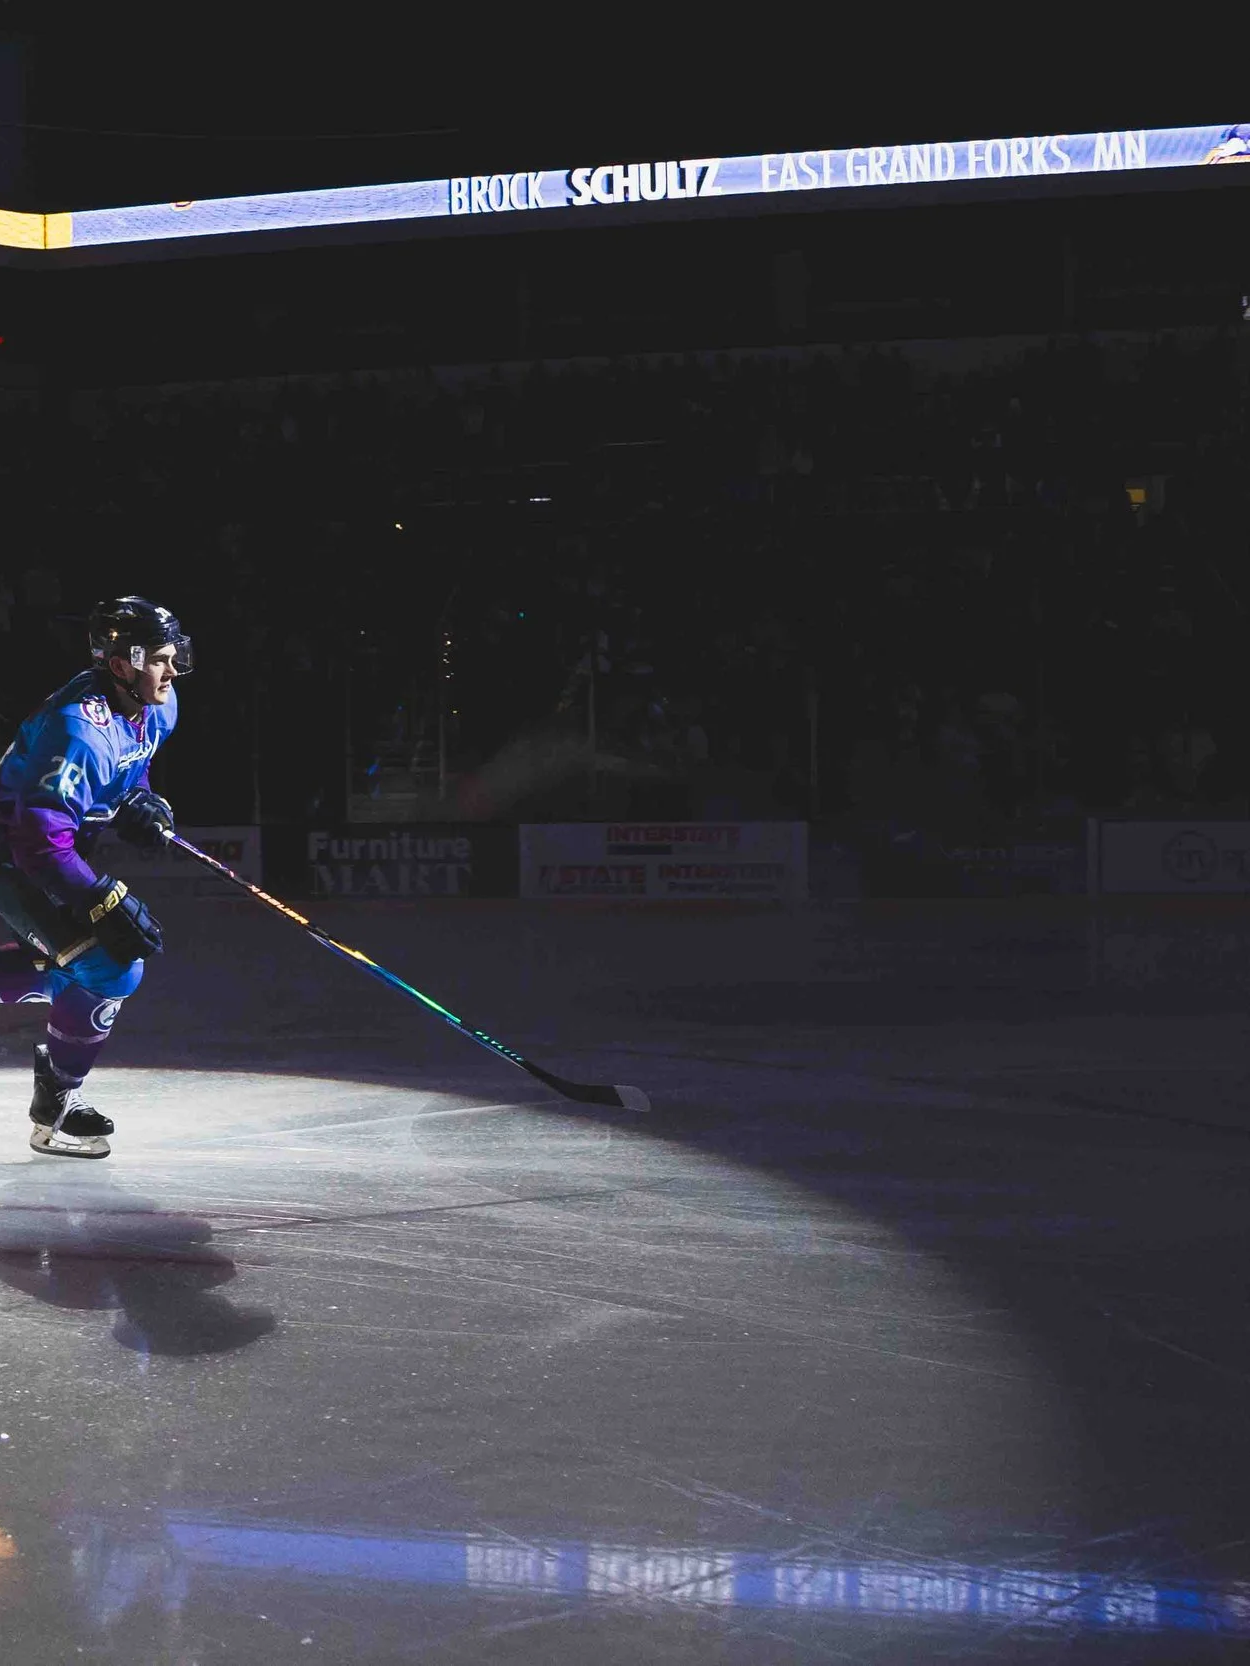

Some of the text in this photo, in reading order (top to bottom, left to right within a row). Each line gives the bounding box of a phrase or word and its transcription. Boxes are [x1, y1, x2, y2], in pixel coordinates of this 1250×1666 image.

[451, 129, 1147, 215] BROCK SCHULTZ EAST GRAND FORKS MN
[307, 831, 472, 861] Furniture
[308, 863, 473, 895] MART
